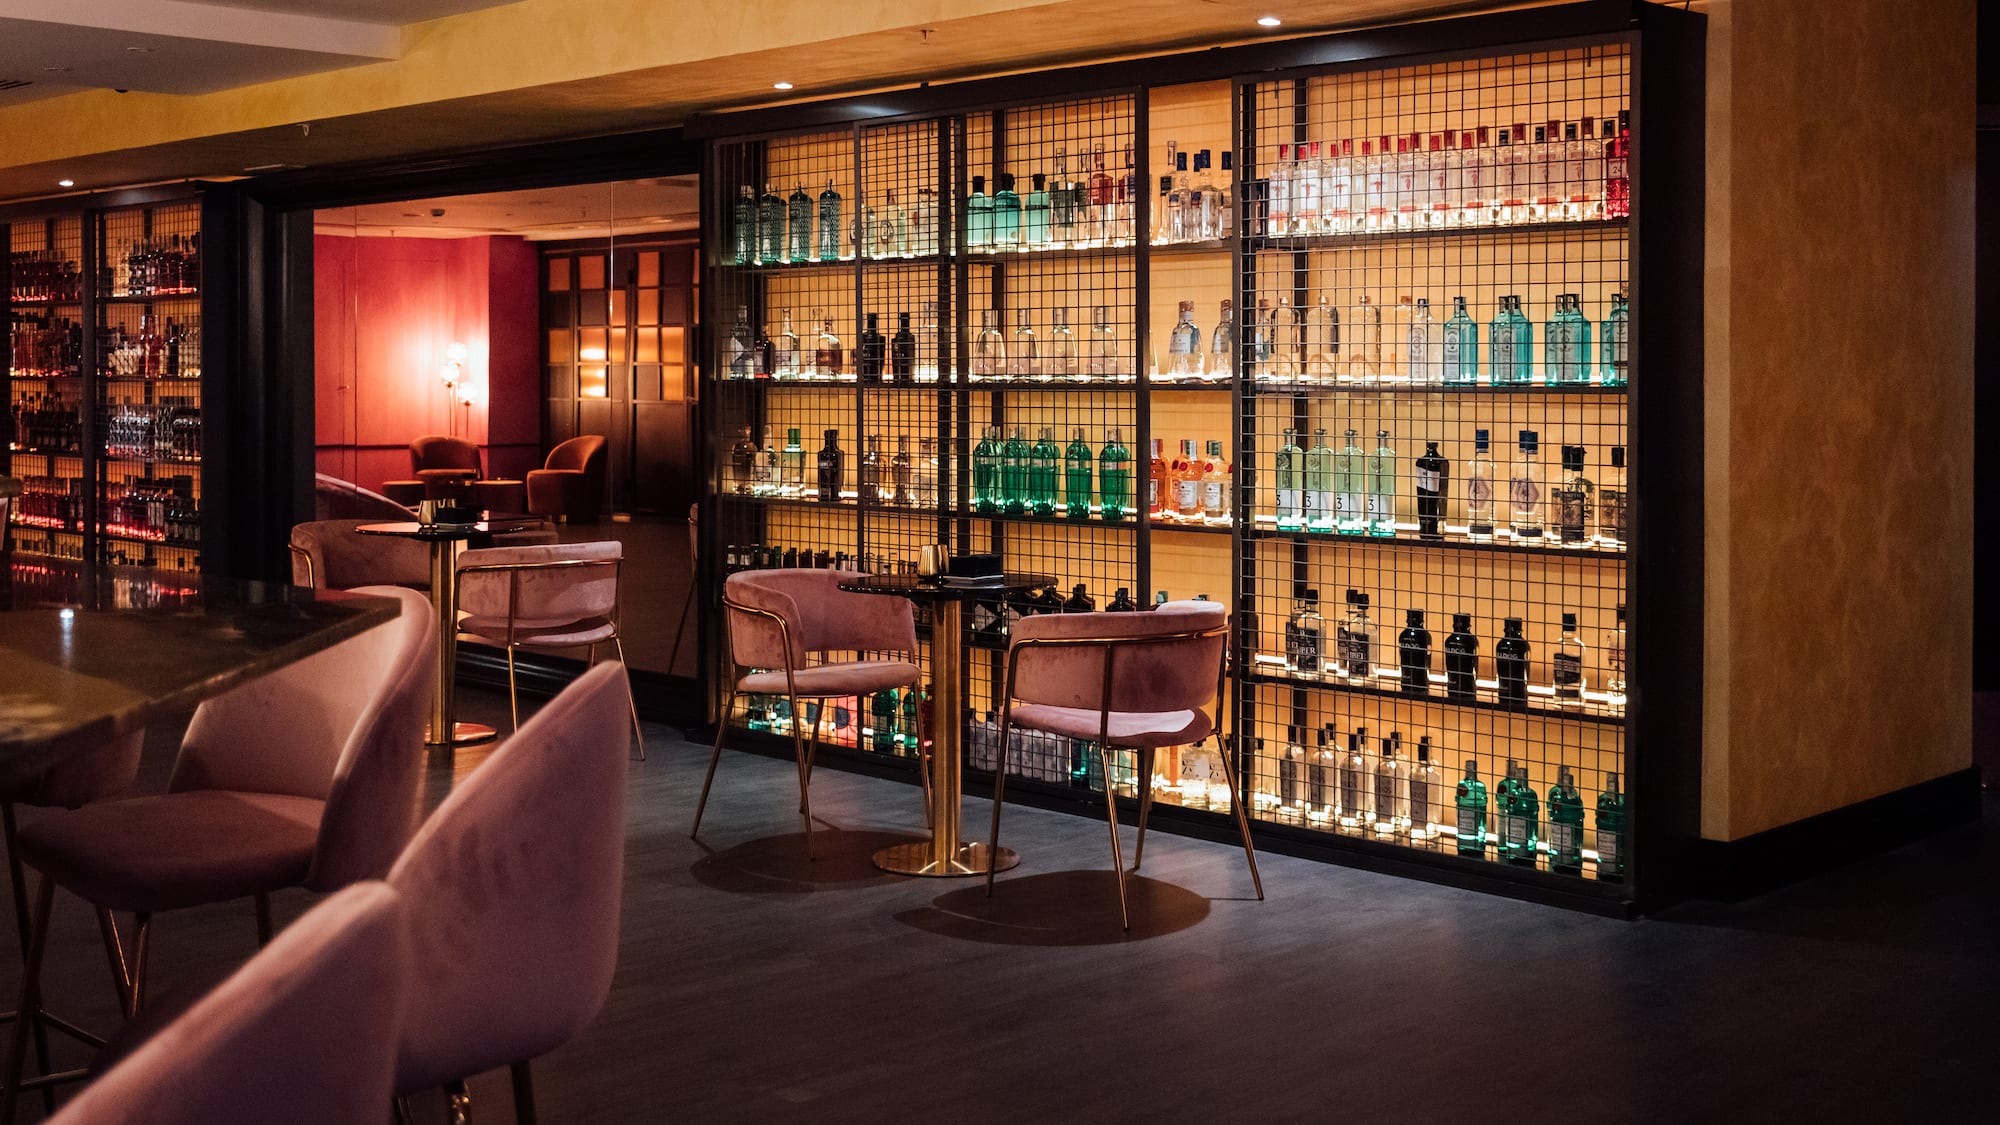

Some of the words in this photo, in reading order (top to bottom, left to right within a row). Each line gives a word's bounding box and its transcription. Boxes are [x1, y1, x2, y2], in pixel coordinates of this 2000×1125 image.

[1305, 496, 1312, 508] 3
[1336, 497, 1343, 510] 3
[1368, 499, 1375, 511] 3
